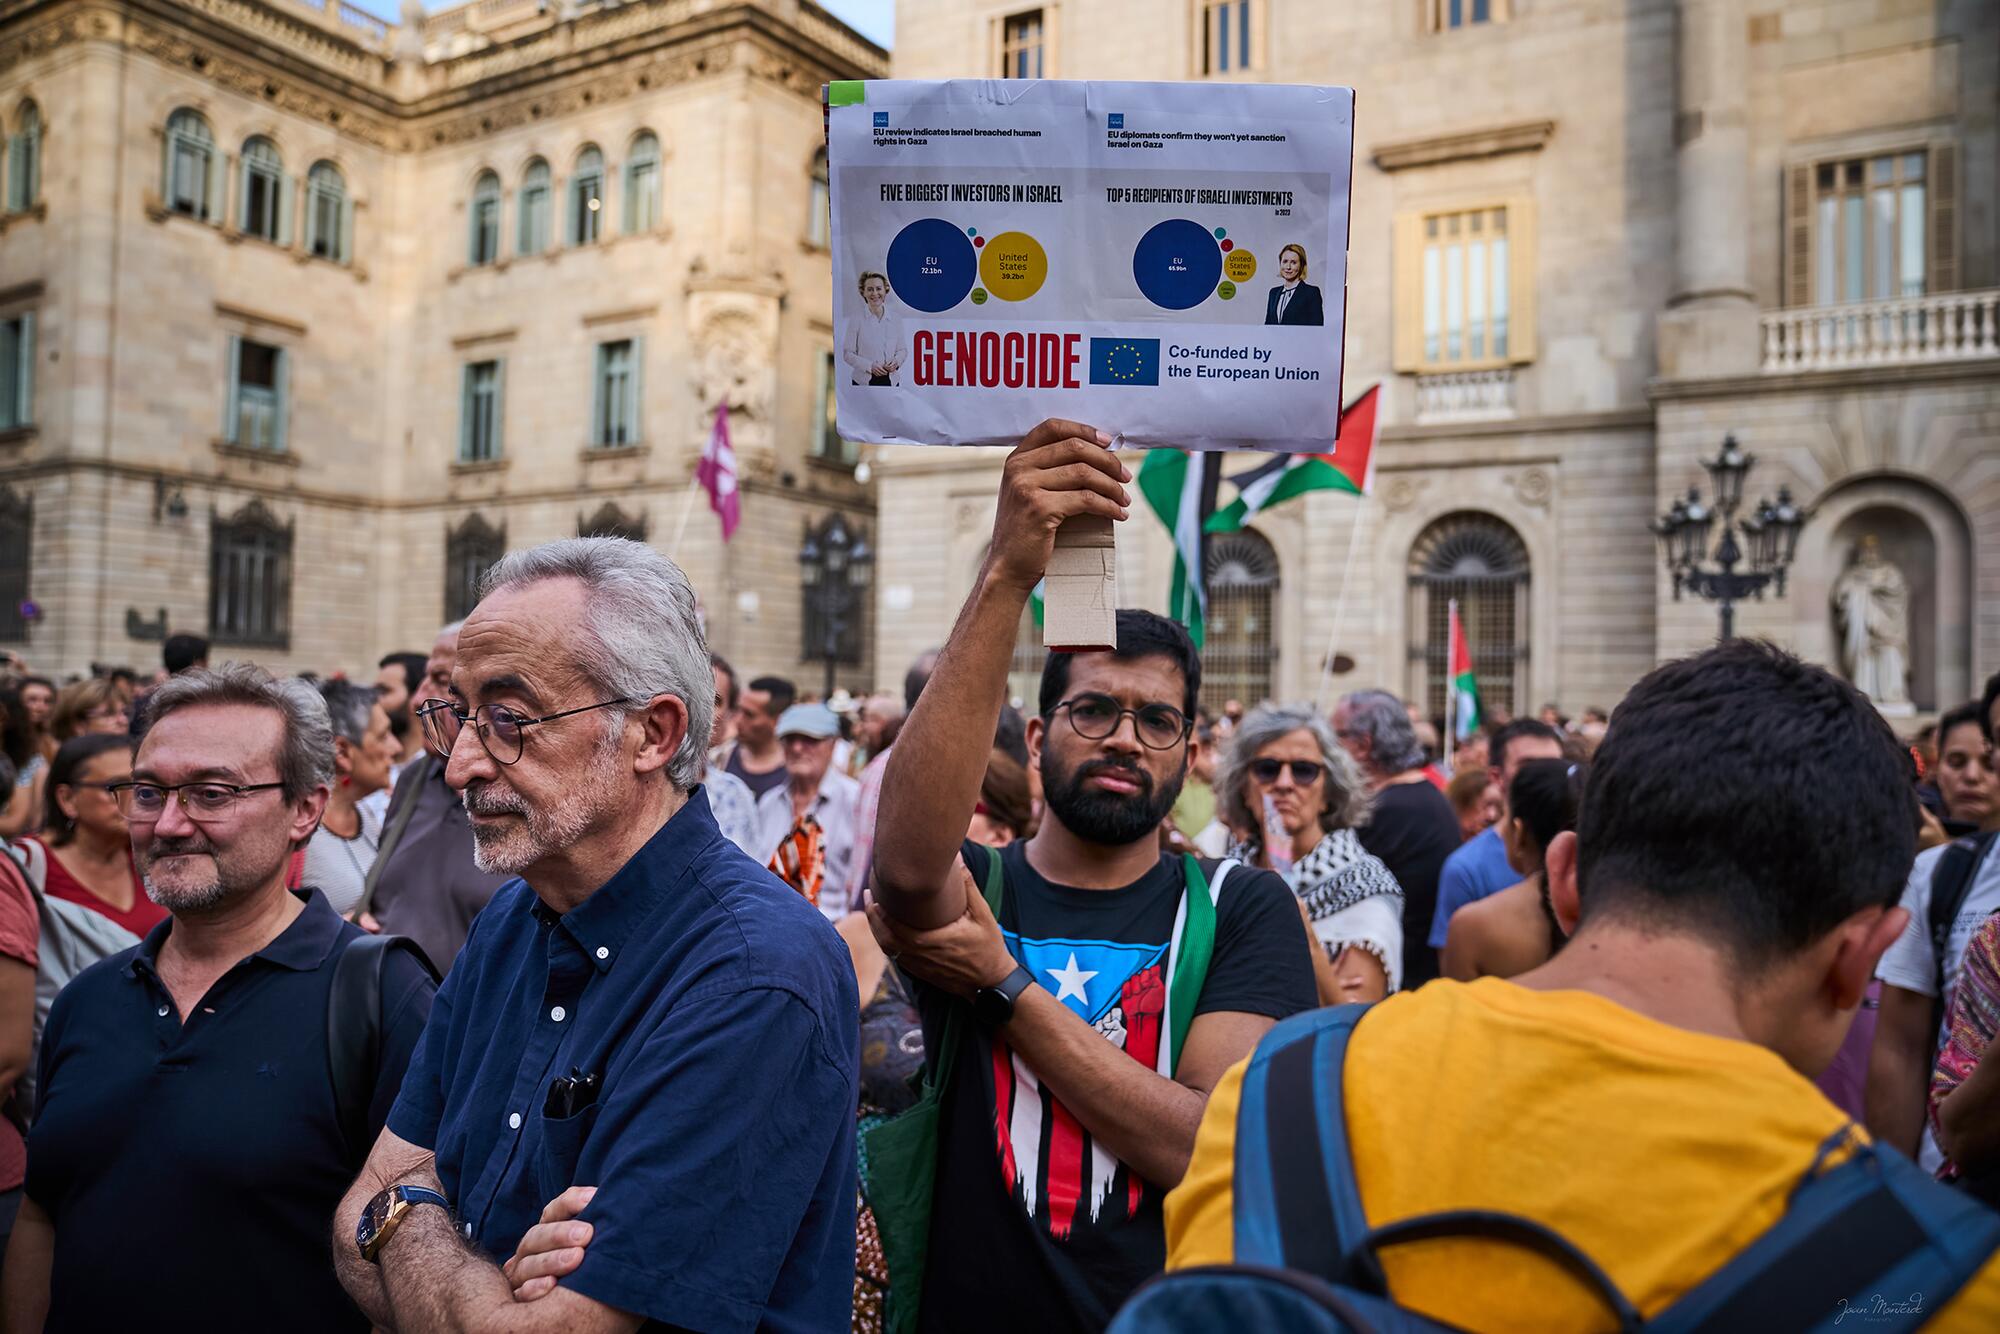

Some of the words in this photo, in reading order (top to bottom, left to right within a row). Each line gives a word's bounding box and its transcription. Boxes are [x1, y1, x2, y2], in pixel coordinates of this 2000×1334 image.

[873, 128, 885, 136] EU
[885, 128, 912, 136] review
[913, 128, 950, 137] indicates
[951, 128, 973, 137] Israel
[974, 128, 1012, 137] breached
[1013, 128, 1041, 137] human
[1107, 131, 1119, 139] EU
[1120, 131, 1160, 141] diplomats
[1161, 131, 1193, 140] confirm
[1194, 132, 1213, 142] they
[1213, 133, 1235, 141] won't
[1236, 133, 1250, 143] yet
[1250, 133, 1286, 142] sanction
[873, 137, 898, 147] rights
[898, 137, 906, 145] in
[907, 137, 927, 145] Gaza
[1107, 140, 1130, 148] Israel
[1142, 140, 1163, 149] Gaza
[880, 183, 903, 202] FIVE
[905, 184, 949, 202] BIGGEST
[951, 184, 1010, 203] INVESTORS
[1012, 185, 1024, 203] IN
[1026, 185, 1063, 203] ISRAEL
[1106, 188, 1124, 203] TOP
[1124, 188, 1131, 203] 5
[1133, 188, 1183, 204] RECIPIENTS
[1184, 189, 1196, 204] OF
[1197, 189, 1231, 205] ISRAELI
[1232, 190, 1293, 206] INVESTMENTS
[925, 257, 938, 265] EU
[998, 253, 1028, 262] United
[1173, 257, 1183, 265] EU
[999, 262, 1027, 271] States
[913, 329, 1081, 389] GENOCIDE
[1168, 345, 1248, 360] Co-funded
[1253, 347, 1272, 363] by
[1168, 365, 1192, 378] the
[1196, 365, 1269, 382] European
[1275, 367, 1320, 381] Union
